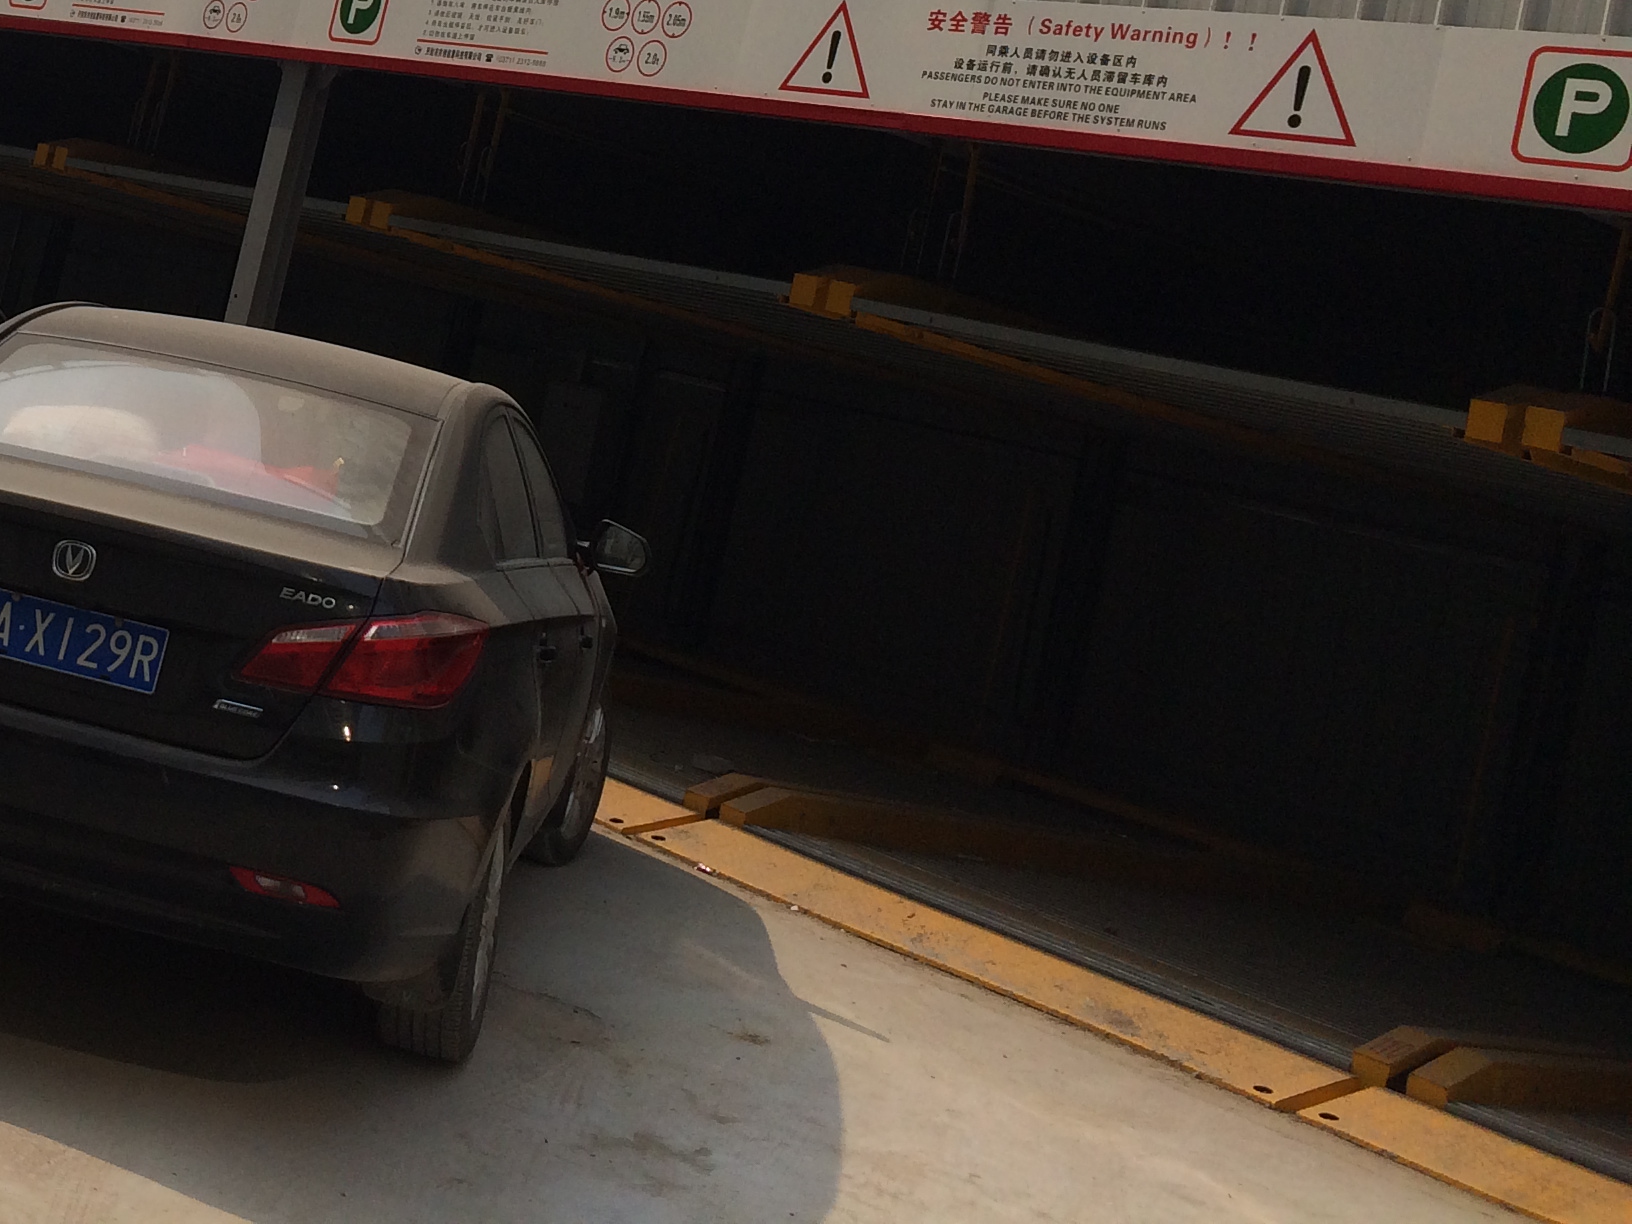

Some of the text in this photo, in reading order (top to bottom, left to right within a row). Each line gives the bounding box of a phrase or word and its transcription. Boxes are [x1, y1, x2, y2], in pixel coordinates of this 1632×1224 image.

[608, 7, 625, 19] 1.9m
[927, 9, 1014, 36] 安全警告
[921, 70, 1197, 103] PASSENGERS DO NOT ENTER INTO THE EQUIPMENT AREA
[930, 98, 1167, 131] STAY IN THE GARAGE BEFORE THE SYSTEM RUNS
[982, 91, 1120, 114] PLEASE MAKE SURE NO ONE
[1555, 77, 1613, 137] P
[279, 586, 337, 610] EADO
